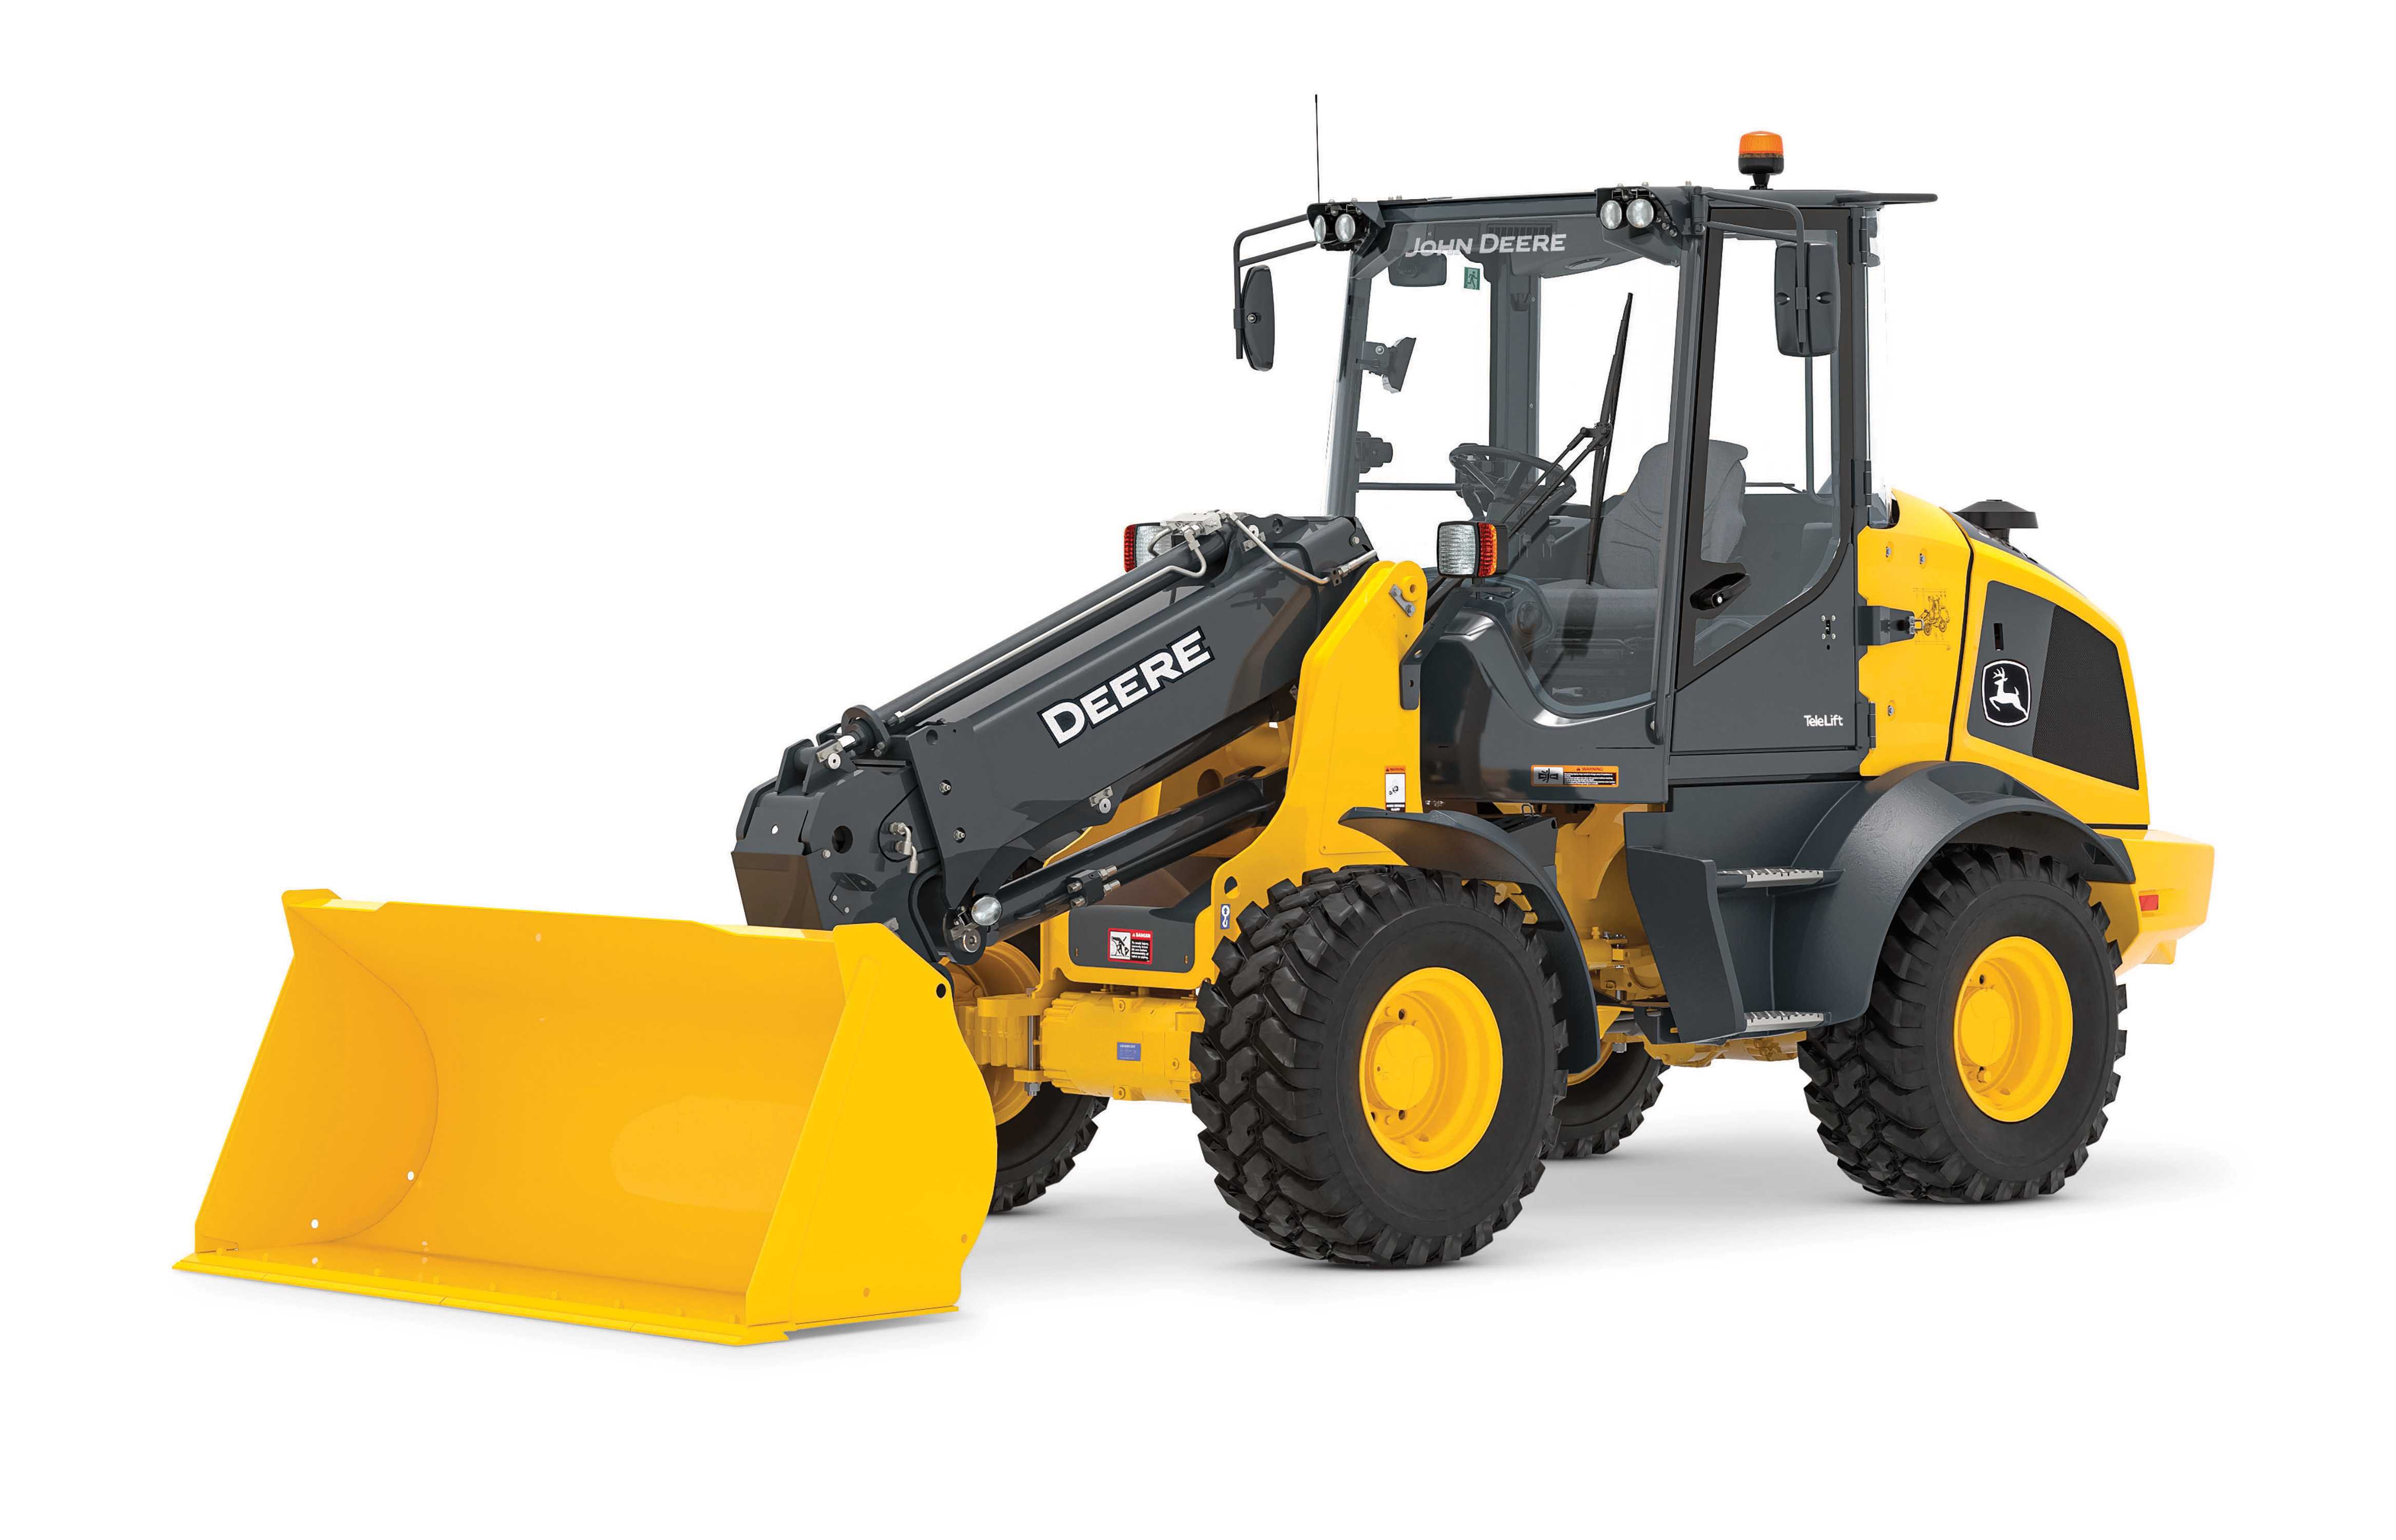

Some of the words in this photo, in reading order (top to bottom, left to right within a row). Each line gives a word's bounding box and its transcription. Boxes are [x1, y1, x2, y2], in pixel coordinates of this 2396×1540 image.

[1406, 238, 1473, 257] JOHN
[1479, 234, 1567, 254] DEERE
[1041, 629, 1212, 745] DEERE
[1804, 715, 1843, 726] TeleLift
